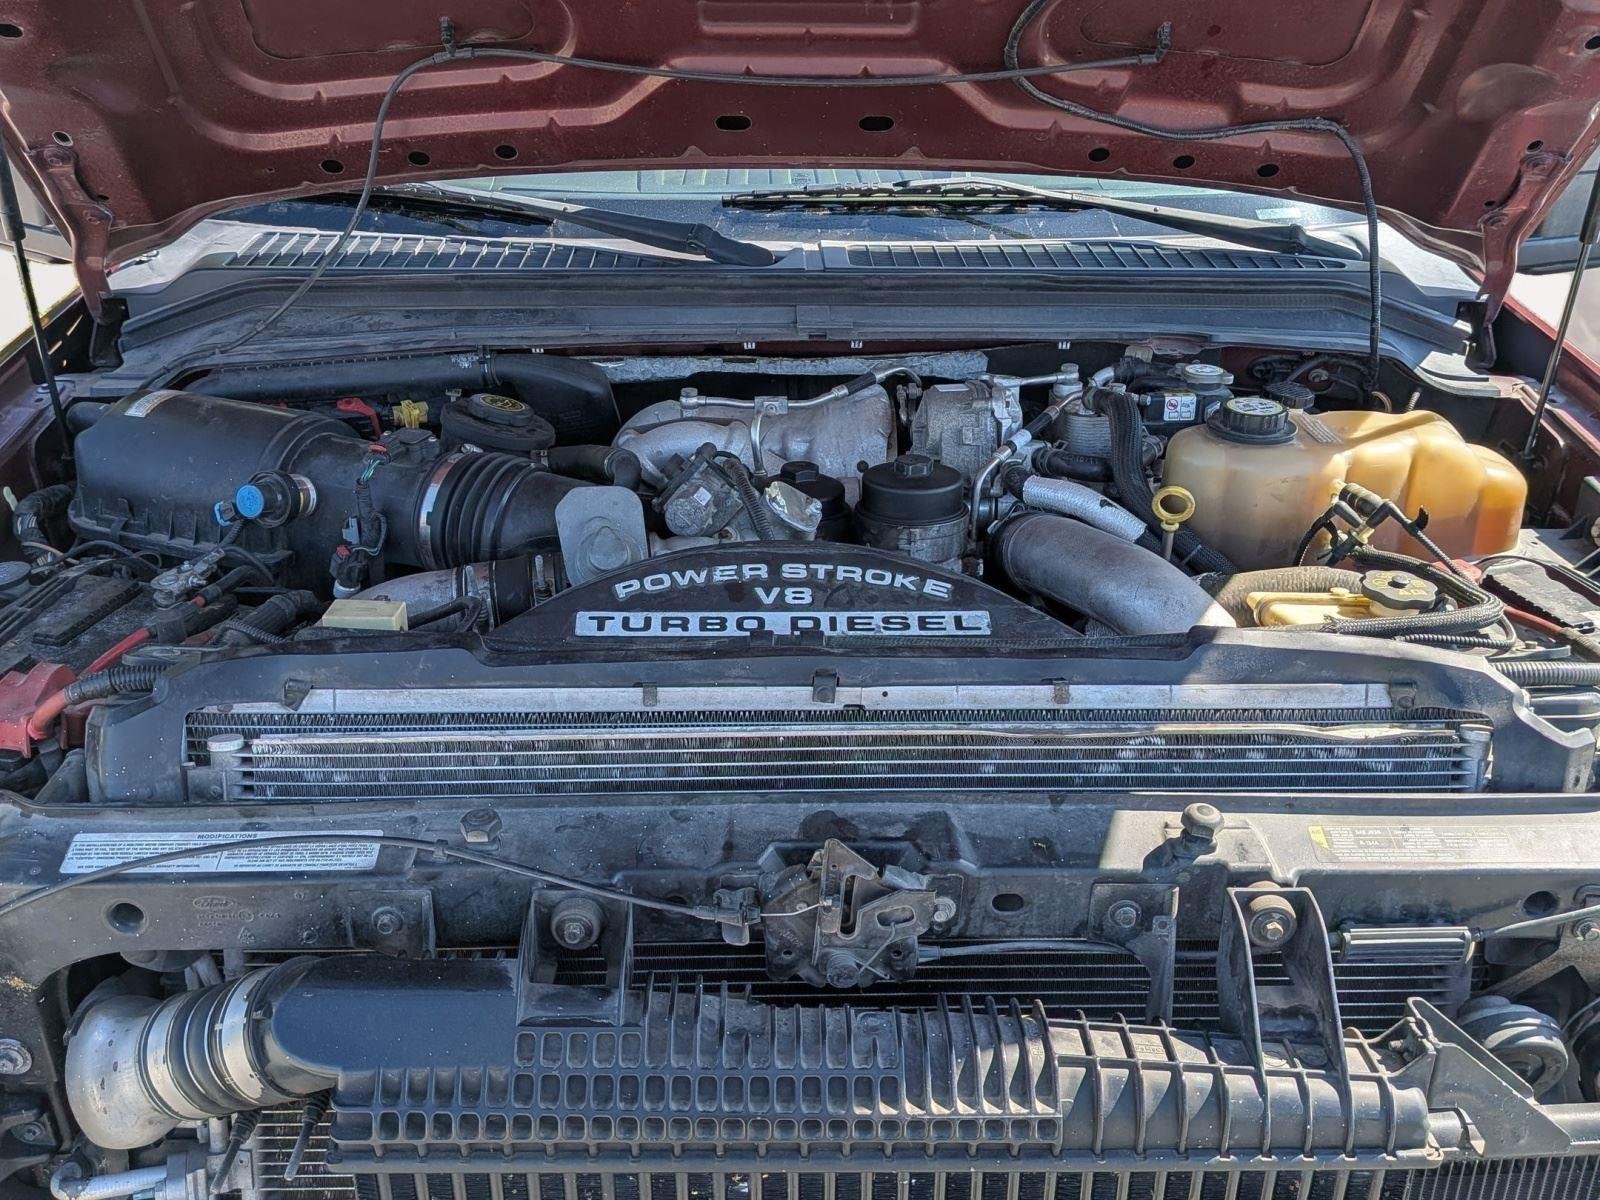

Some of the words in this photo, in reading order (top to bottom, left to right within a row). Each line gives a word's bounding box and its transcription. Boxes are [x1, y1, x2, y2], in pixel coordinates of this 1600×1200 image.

[614, 563, 769, 599] POWER
[781, 563, 953, 598] STROKE
[754, 587, 813, 605] V8
[588, 615, 766, 633] TURBO
[790, 615, 983, 633] DIESEL
